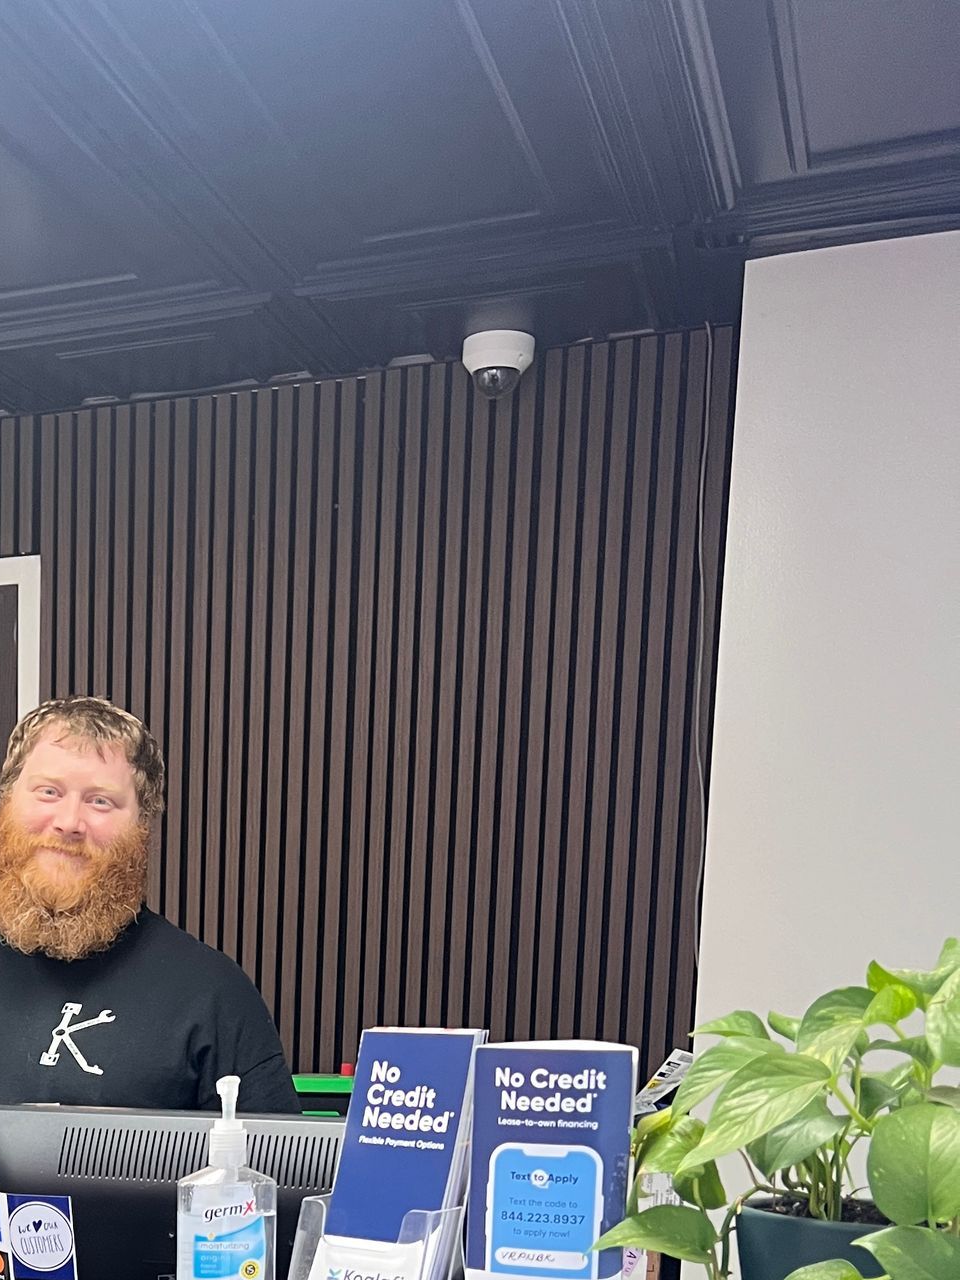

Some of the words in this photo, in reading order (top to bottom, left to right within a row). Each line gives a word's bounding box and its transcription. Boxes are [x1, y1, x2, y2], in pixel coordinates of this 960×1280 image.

[370, 1060, 401, 1083] No
[495, 1067, 525, 1088] No
[530, 1068, 607, 1090] Credit
[367, 1083, 436, 1108] Credit
[497, 1117, 556, 1127] Lease-to-own
[557, 1119, 599, 1130] financing
[359, 1135, 385, 1145] Flexible
[385, 1137, 416, 1147] Payment
[416, 1140, 445, 1150] Options
[510, 1171, 531, 1181] Text
[534, 1174, 545, 1182] to
[547, 1173, 579, 1185] Apply
[509, 1197, 526, 1206] Text
[528, 1198, 542, 1206] the
[544, 1200, 566, 1208] code
[569, 1200, 578, 1208] to
[501, 1210, 585, 1225] 844.223.8937
[513, 1227, 522, 1236] to
[523, 1228, 546, 1238] apply
[548, 1230, 570, 1238] now!
[20, 1234, 64, 1255] CUSTOMERS
